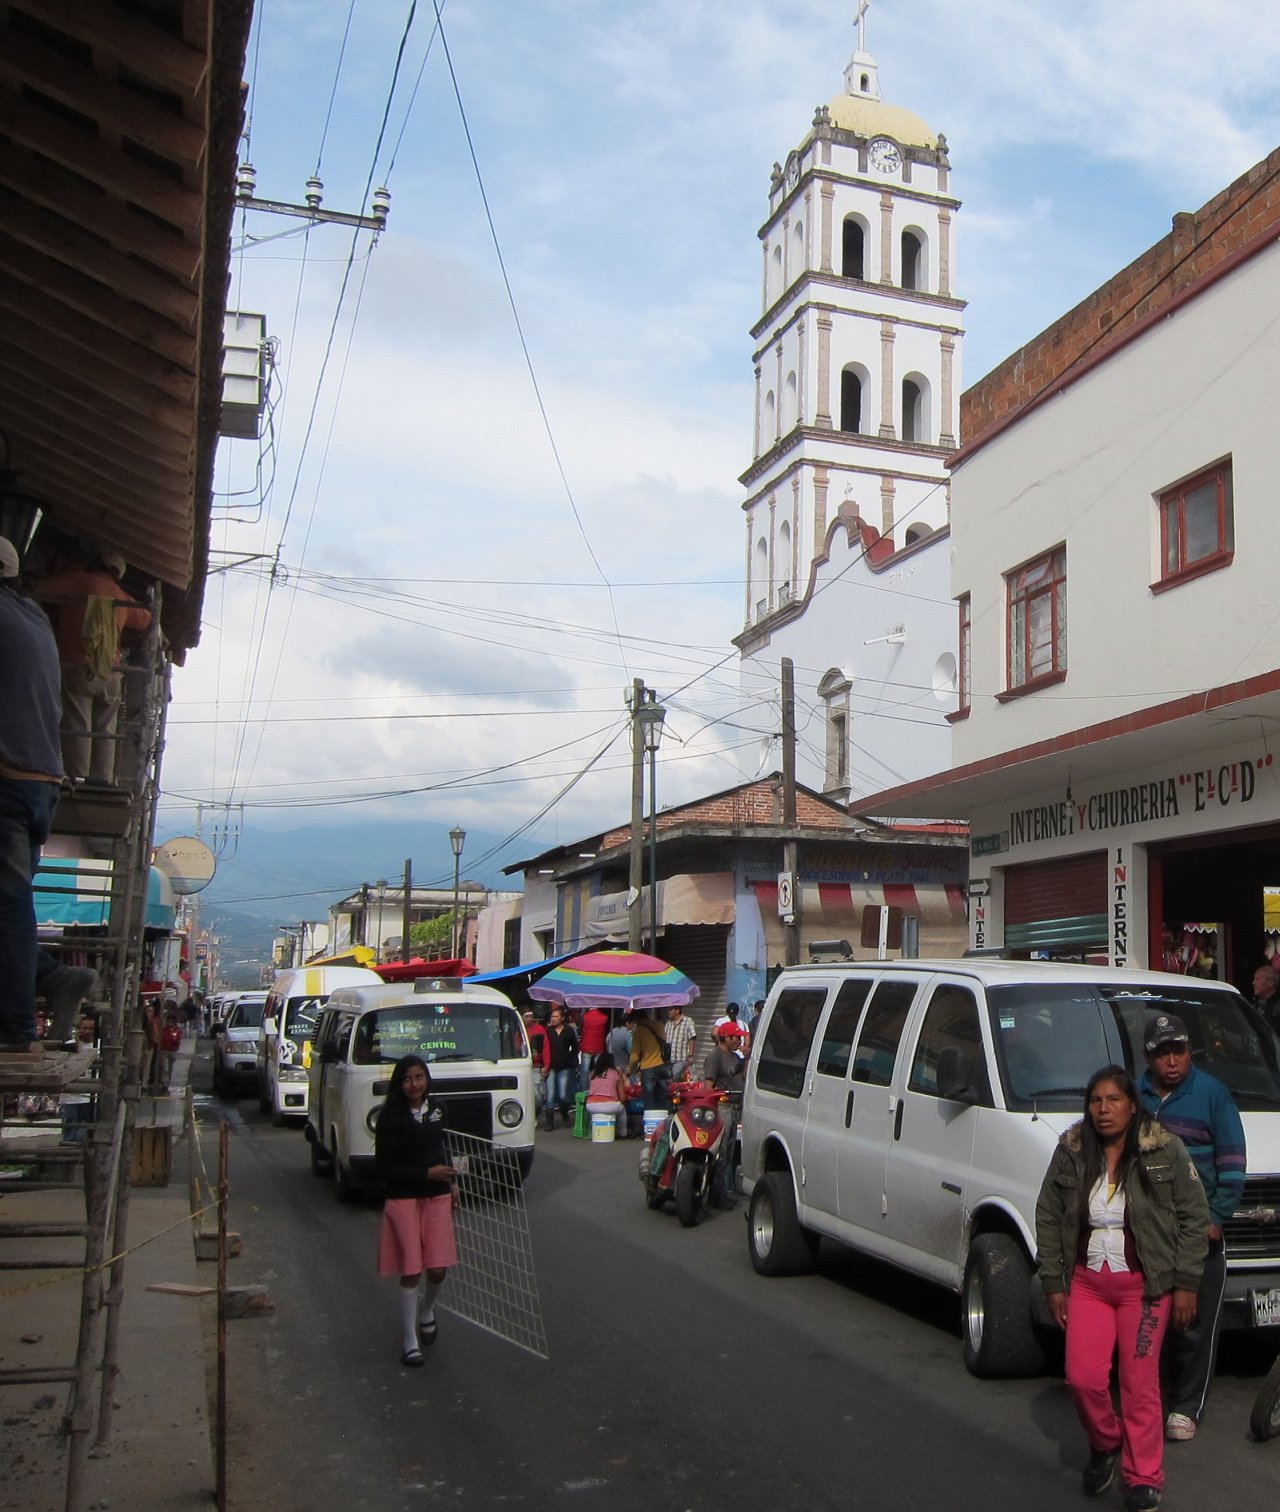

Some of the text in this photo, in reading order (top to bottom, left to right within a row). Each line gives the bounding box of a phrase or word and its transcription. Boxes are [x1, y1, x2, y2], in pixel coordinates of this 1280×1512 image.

[1077, 804, 1088, 830] Y
[1087, 777, 1180, 831] CHURRERIA
[875, 872, 905, 882] PLATA
[975, 896, 986, 949] INTE
[419, 1041, 457, 1050] CENTRO
